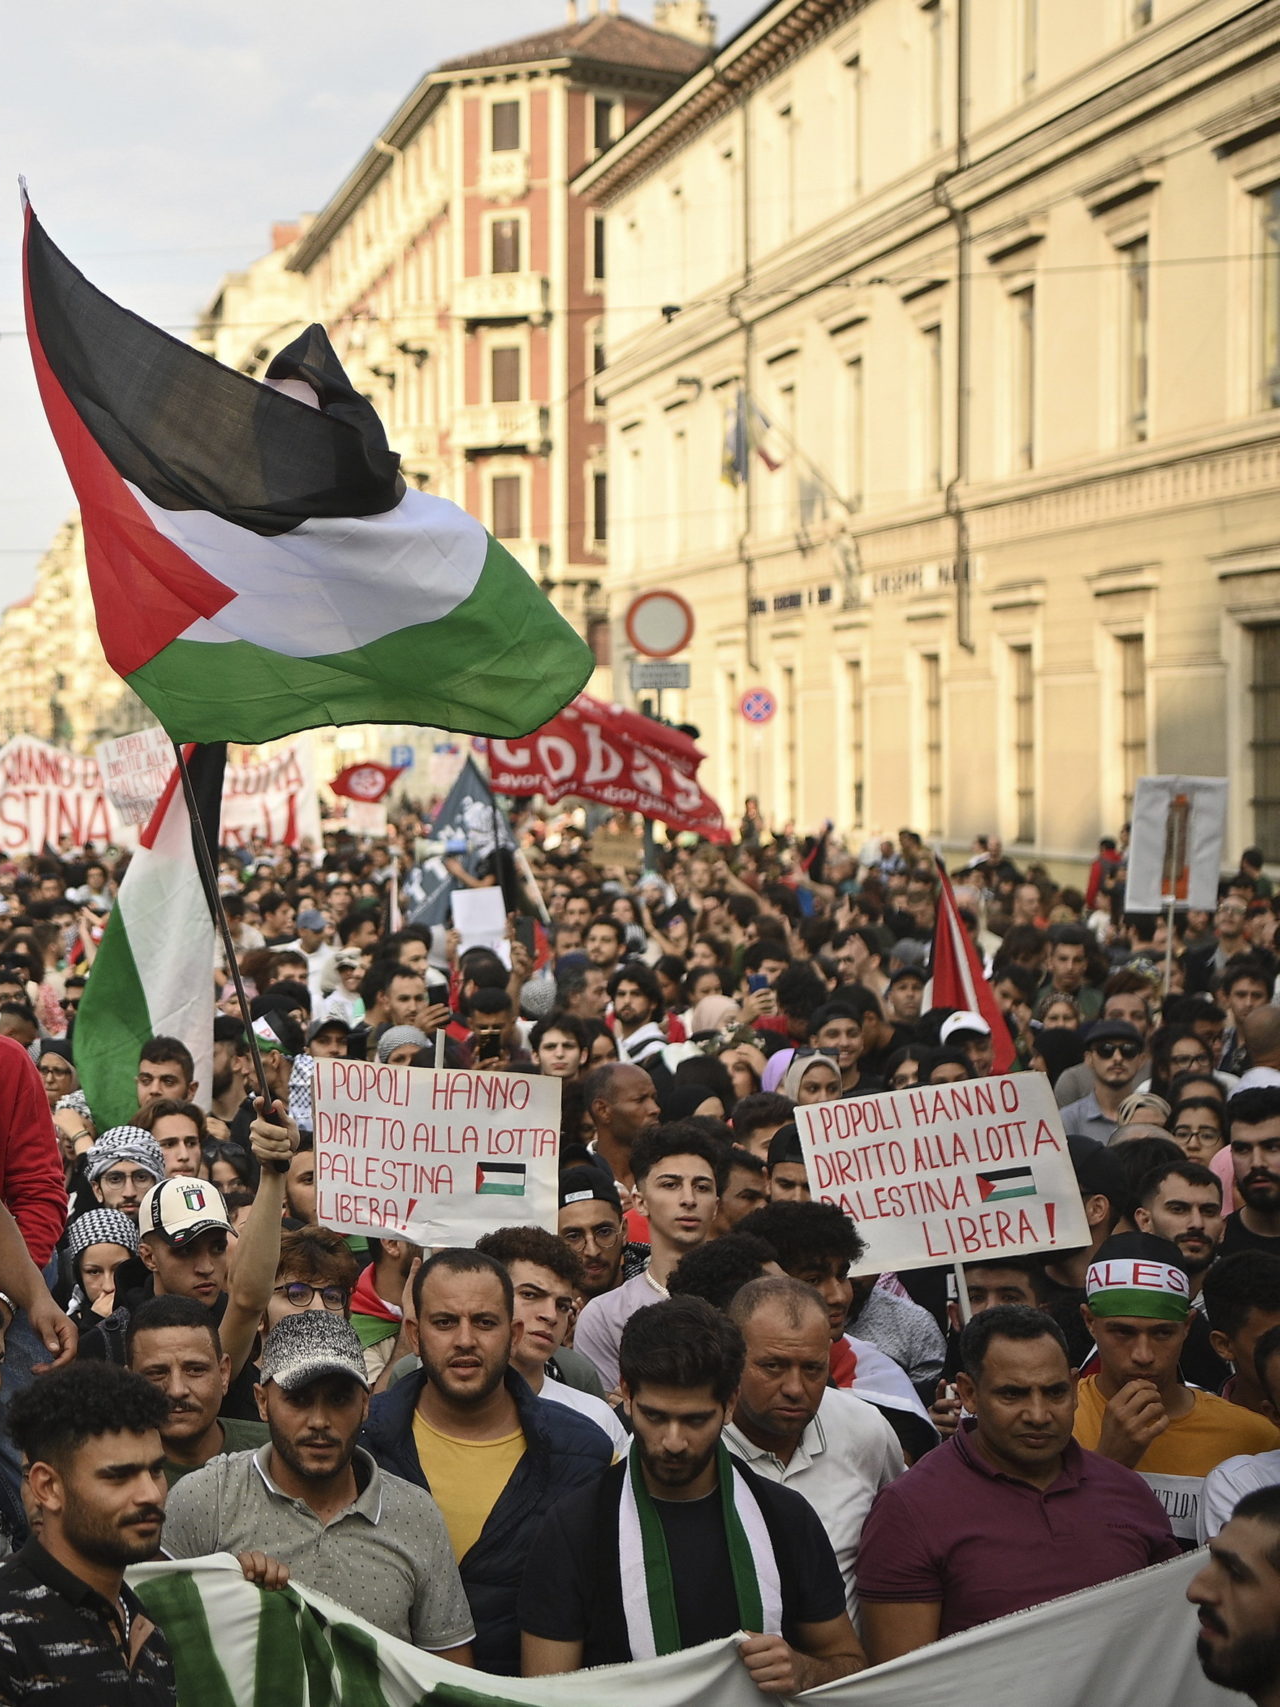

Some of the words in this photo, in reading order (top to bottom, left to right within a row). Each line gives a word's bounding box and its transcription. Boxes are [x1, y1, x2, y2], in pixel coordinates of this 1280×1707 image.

[316, 1062, 321, 1100] I
[332, 1061, 411, 1107] POPOLI
[432, 1072, 531, 1111] HANNO
[319, 1111, 406, 1151] DIRITTO
[413, 1122, 479, 1153] ALLA
[487, 1127, 557, 1158] LOTTA
[805, 1111, 816, 1145] I
[820, 1096, 902, 1144] POPOLI
[909, 1079, 1020, 1127] HANNO
[319, 1151, 454, 1195] PALESTINA
[814, 1139, 907, 1189] DIRITTO
[914, 1132, 970, 1171] ALLA
[973, 1119, 1062, 1164] LOTTA
[319, 1191, 418, 1231] LIBERA!
